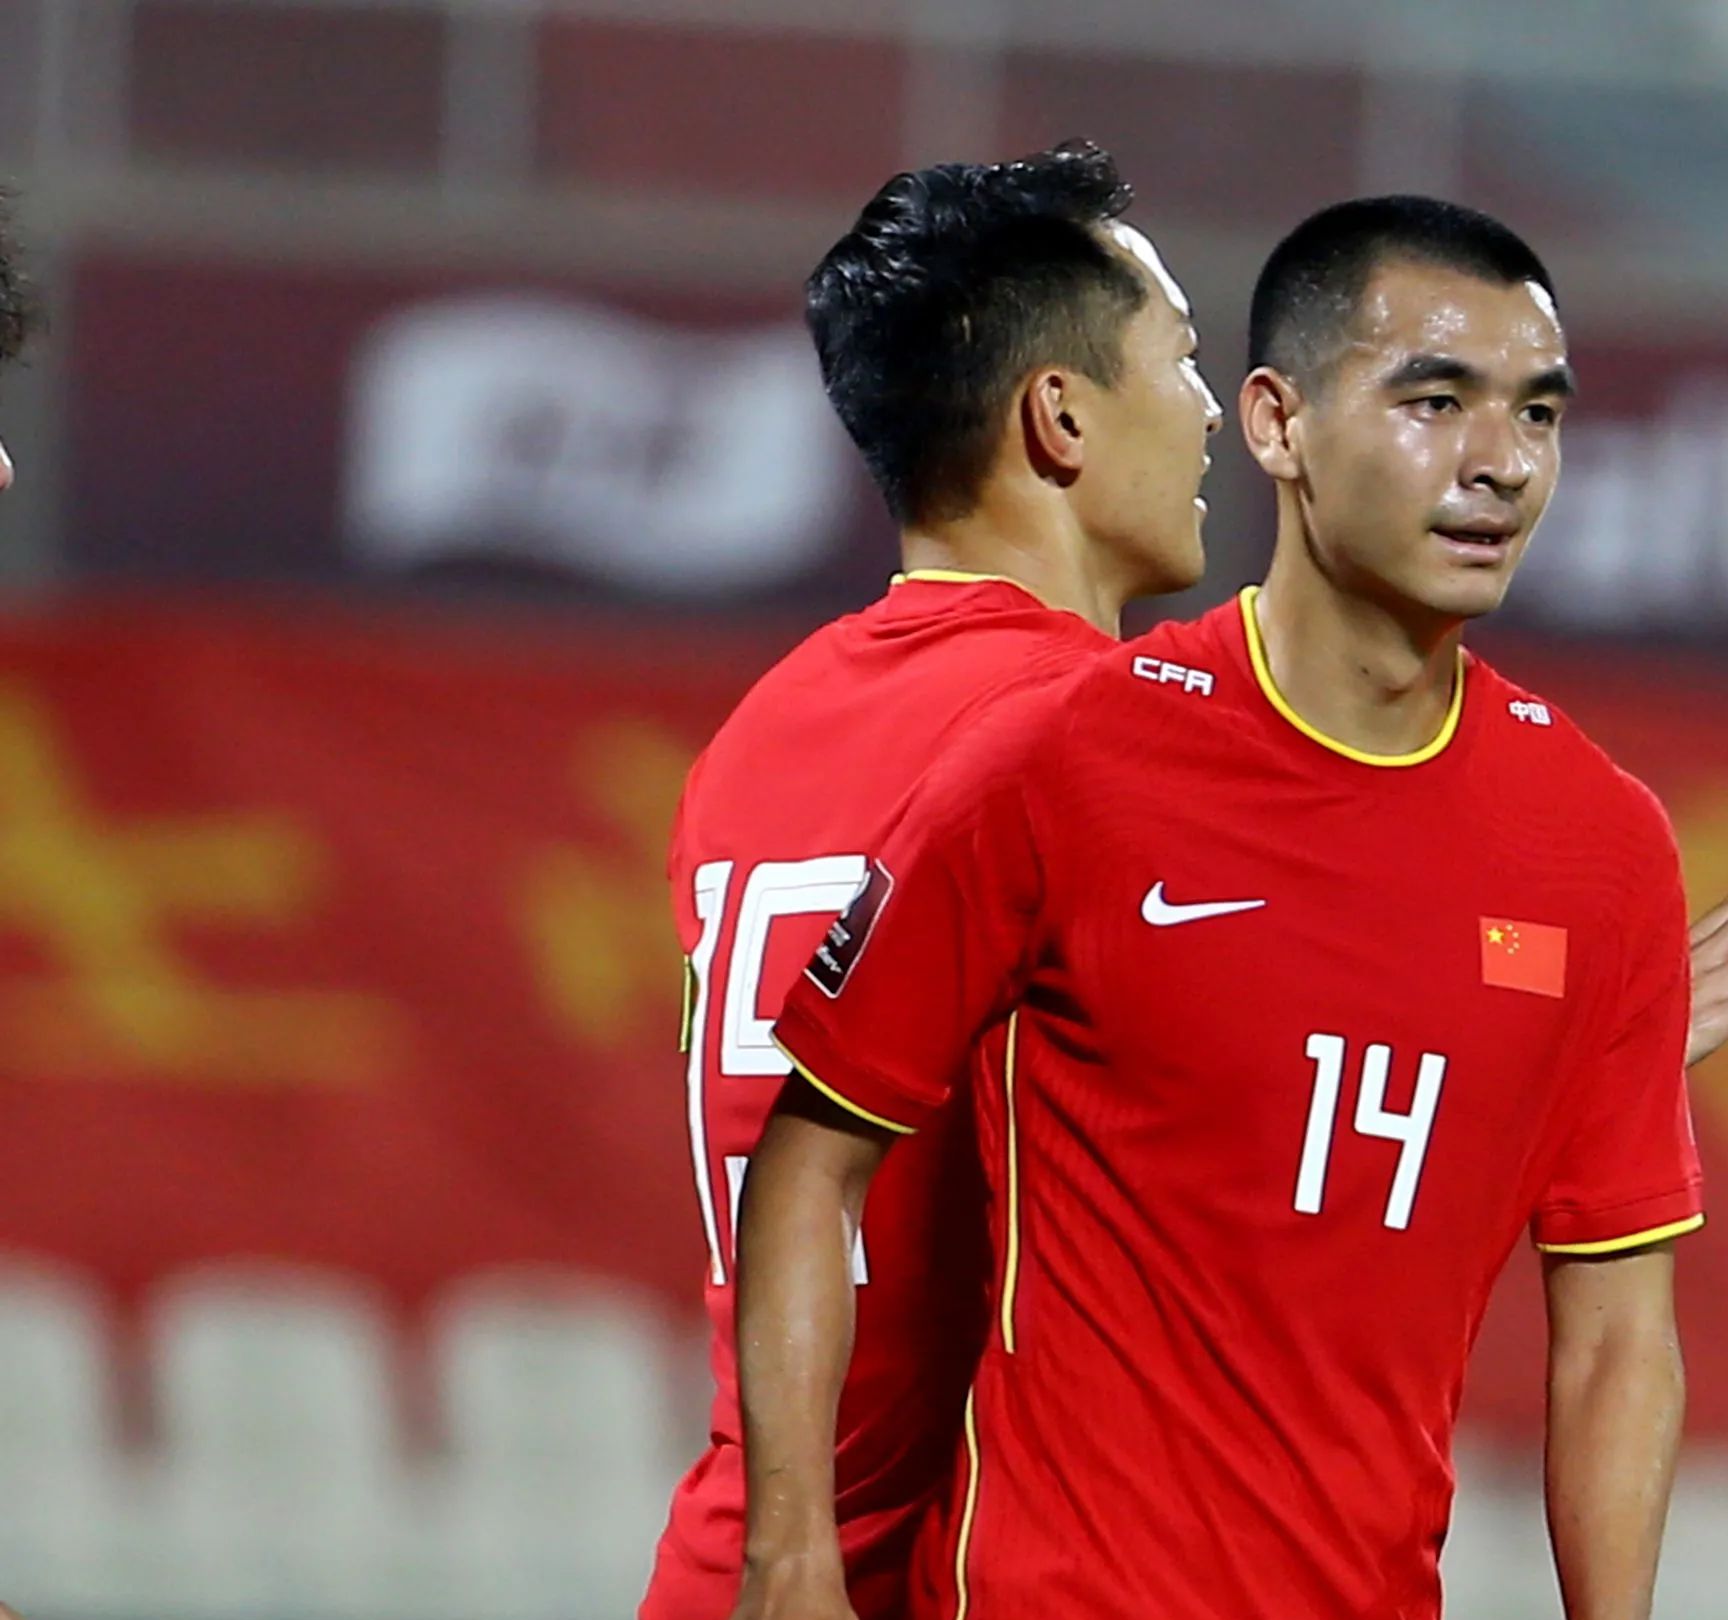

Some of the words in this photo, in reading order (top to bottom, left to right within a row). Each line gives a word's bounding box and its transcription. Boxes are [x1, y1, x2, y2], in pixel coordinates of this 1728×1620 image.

[1133, 655, 1213, 697] CFA
[1508, 700, 1552, 726] 中国
[1293, 1032, 1448, 1231] 14
